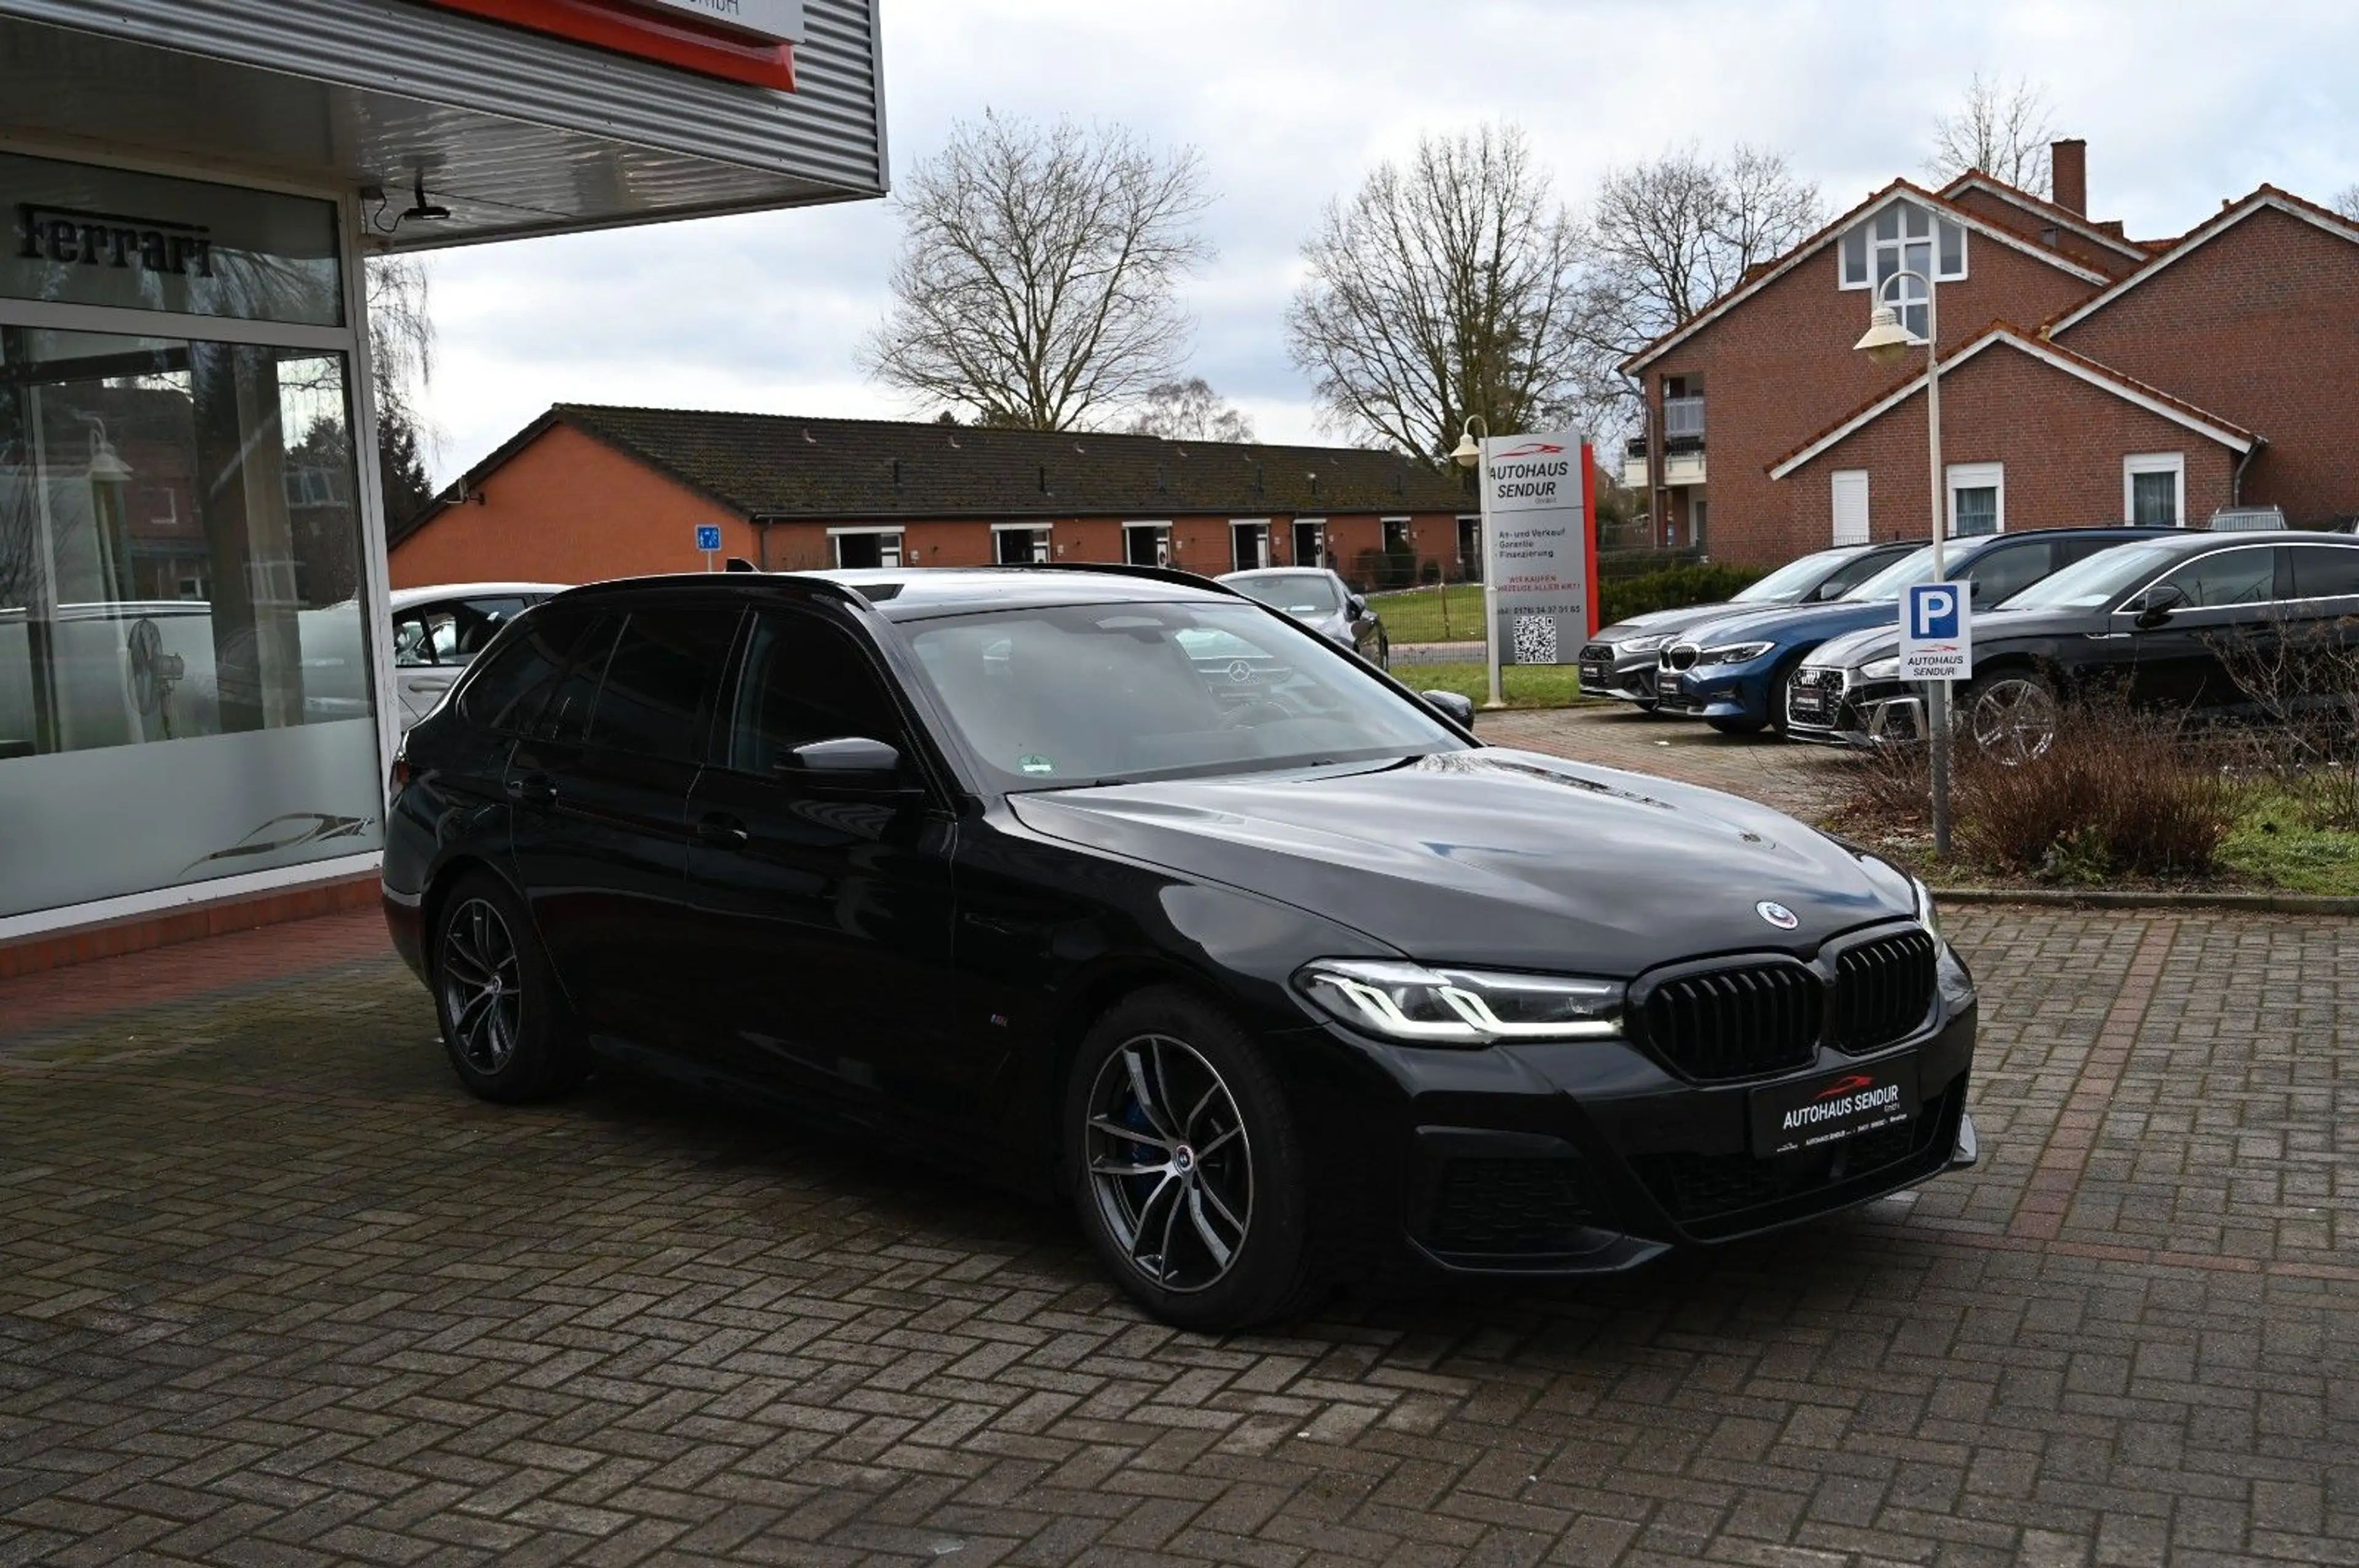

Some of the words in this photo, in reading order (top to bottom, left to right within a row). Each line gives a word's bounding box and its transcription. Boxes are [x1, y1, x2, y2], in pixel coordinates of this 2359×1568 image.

[15, 202, 214, 277] Ferrari
[1490, 461, 1569, 480] AUTOHAUS
[1498, 482, 1556, 499] SENDUR
[1532, 528, 1565, 537] Verkauf
[1920, 591, 1953, 634] P
[1907, 655, 1964, 666] AUTOHAUS
[1914, 667, 1955, 676] SENDUR
[1783, 1099, 1853, 1130] AUTOHAUS
[1854, 1084, 1899, 1111] SENDUR
